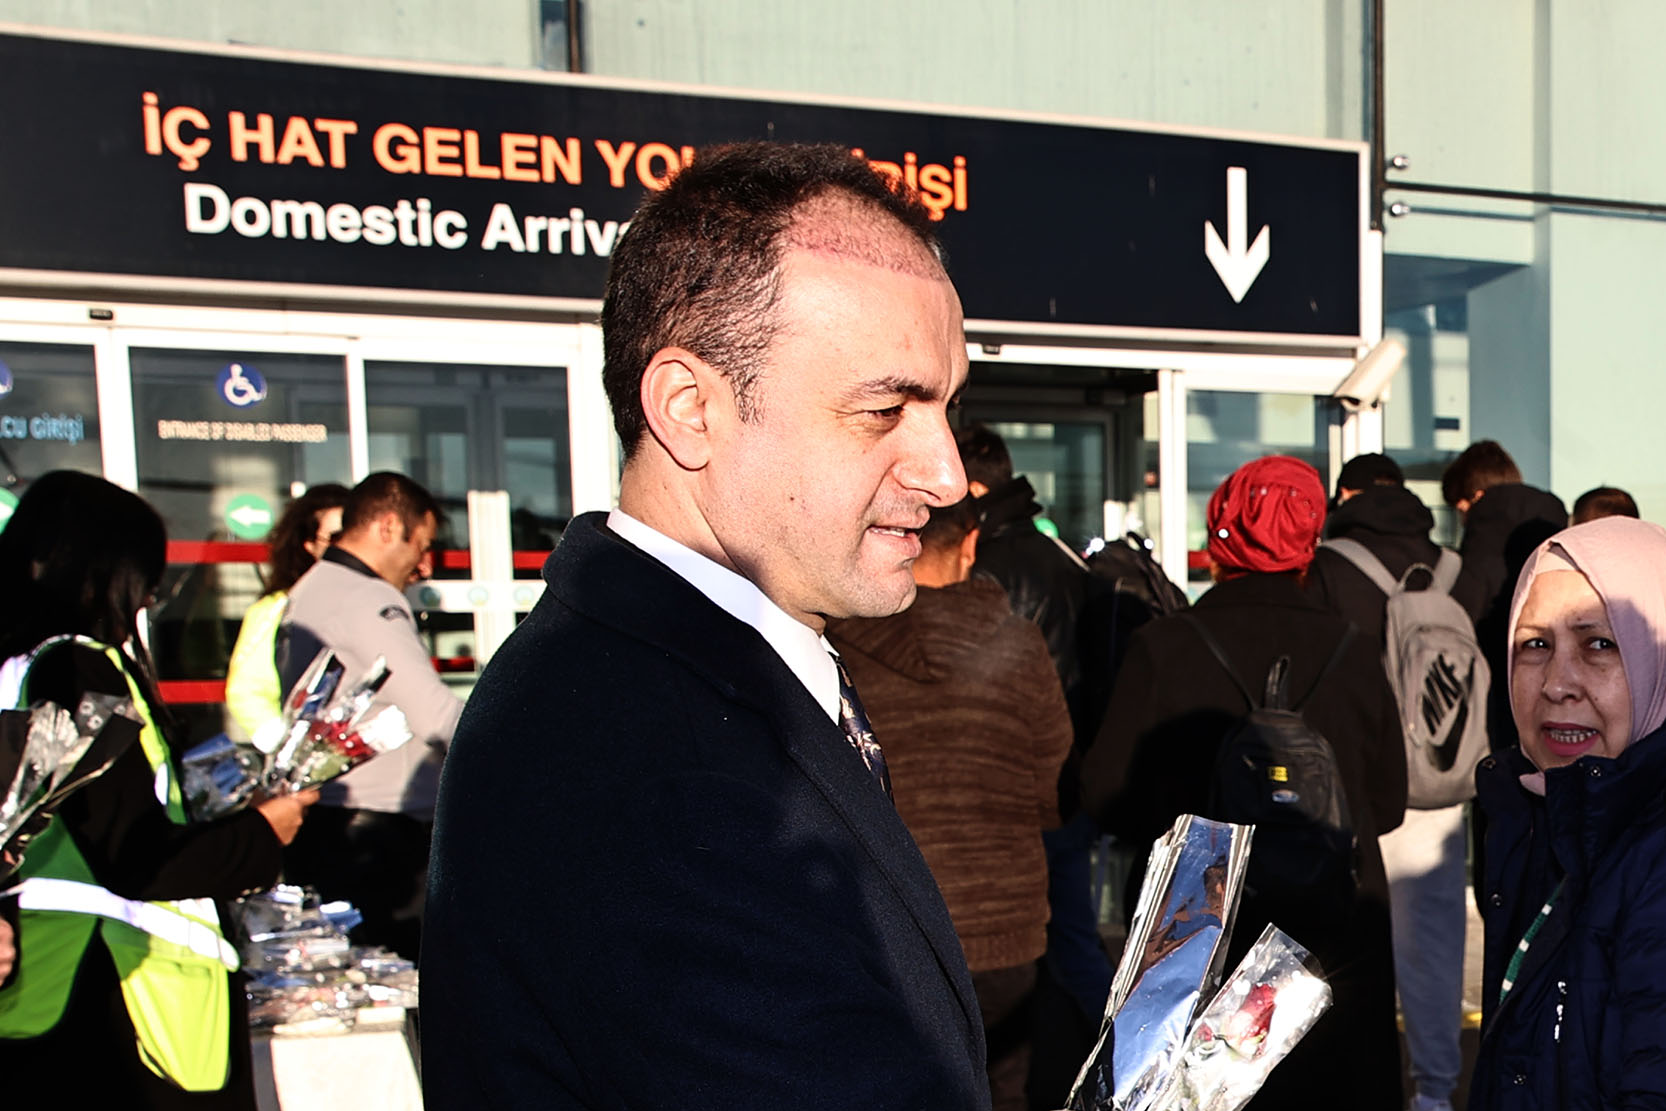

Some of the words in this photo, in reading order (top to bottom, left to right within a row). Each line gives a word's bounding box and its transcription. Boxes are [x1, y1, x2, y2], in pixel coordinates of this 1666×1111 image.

[142, 91, 212, 172] İÇ
[228, 111, 358, 169] HAT
[373, 122, 582, 185] GELEN
[184, 182, 468, 249] Domestic
